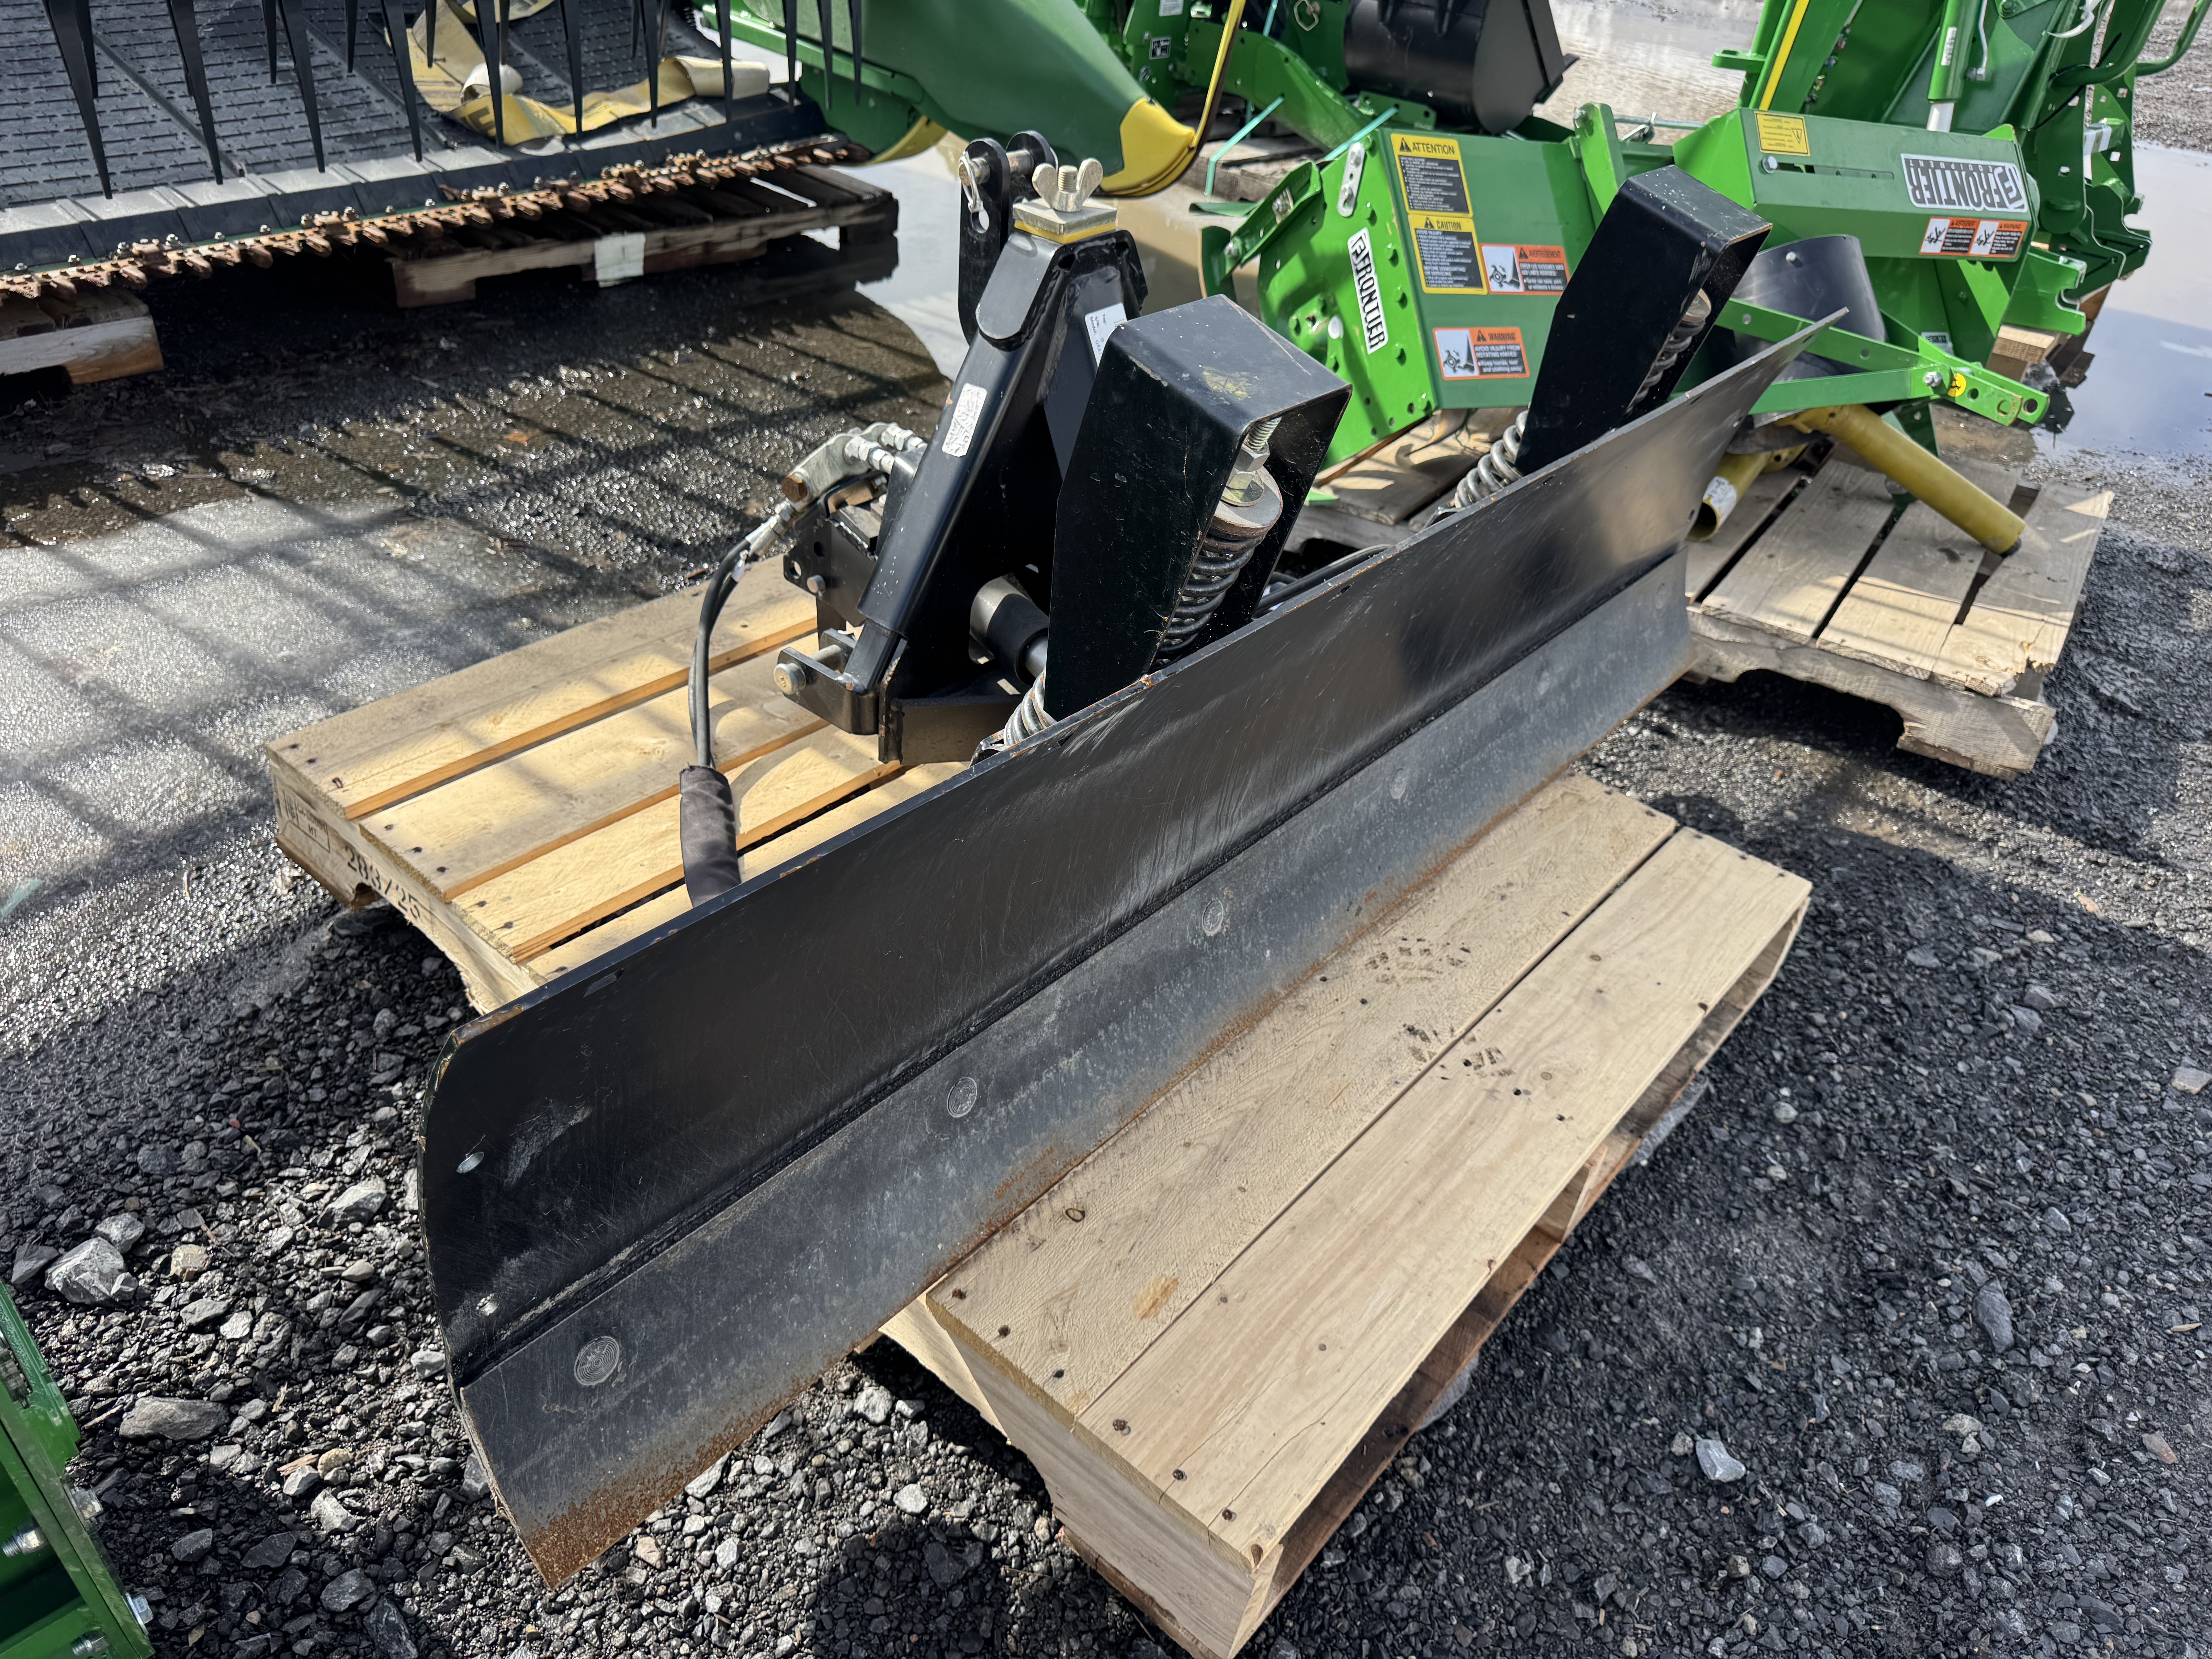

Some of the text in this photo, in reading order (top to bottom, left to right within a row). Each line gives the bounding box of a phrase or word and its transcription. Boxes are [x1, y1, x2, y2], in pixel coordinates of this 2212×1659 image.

[1412, 142, 1455, 155] ATTENTION
[1909, 159, 1993, 172] EQUIPMENT
[1904, 166, 2008, 209] FRONTIER
[1436, 220, 1462, 230] CAUTION
[1356, 251, 1385, 349] FRONTIER
[1489, 333, 1516, 341] WARNING
